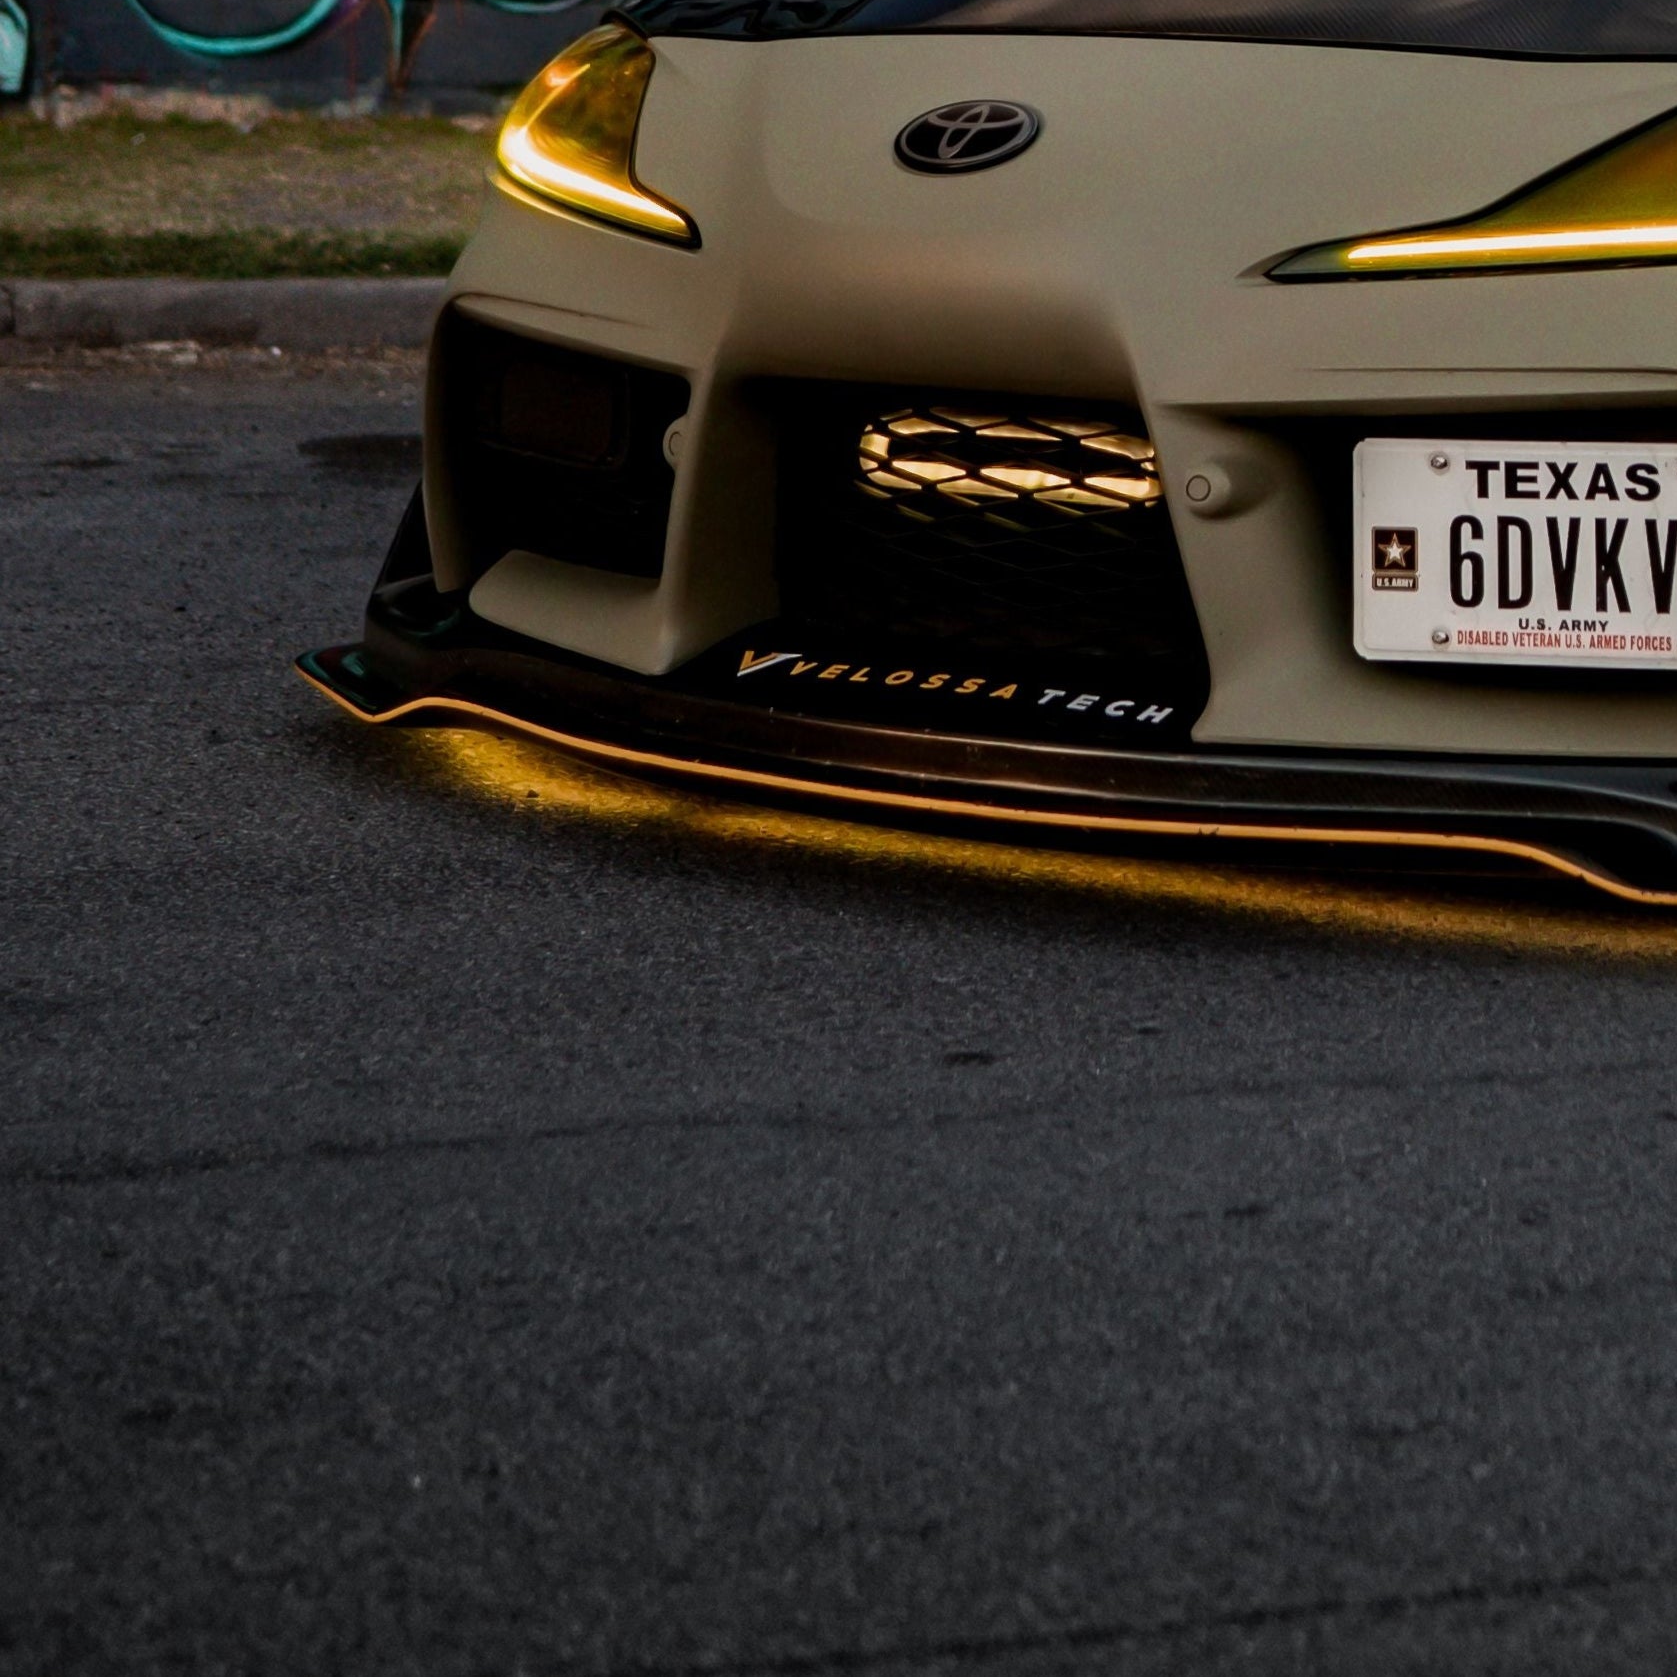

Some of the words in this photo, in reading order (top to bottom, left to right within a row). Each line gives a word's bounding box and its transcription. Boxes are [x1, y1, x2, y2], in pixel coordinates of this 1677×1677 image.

[1465, 459, 1662, 502] TEXAS
[1457, 630, 1509, 647] DISABLED
[1512, 632, 1561, 649] VETERAN
[1564, 633, 1586, 650] U.S.
[1589, 634, 1626, 651] ARMED
[1630, 635, 1673, 652] FORCES
[1518, 618, 1552, 631] U.S.
[1559, 619, 1609, 633] ARMY
[790, 661, 1018, 700] VELOSSA
[1037, 688, 1174, 724] TECH
